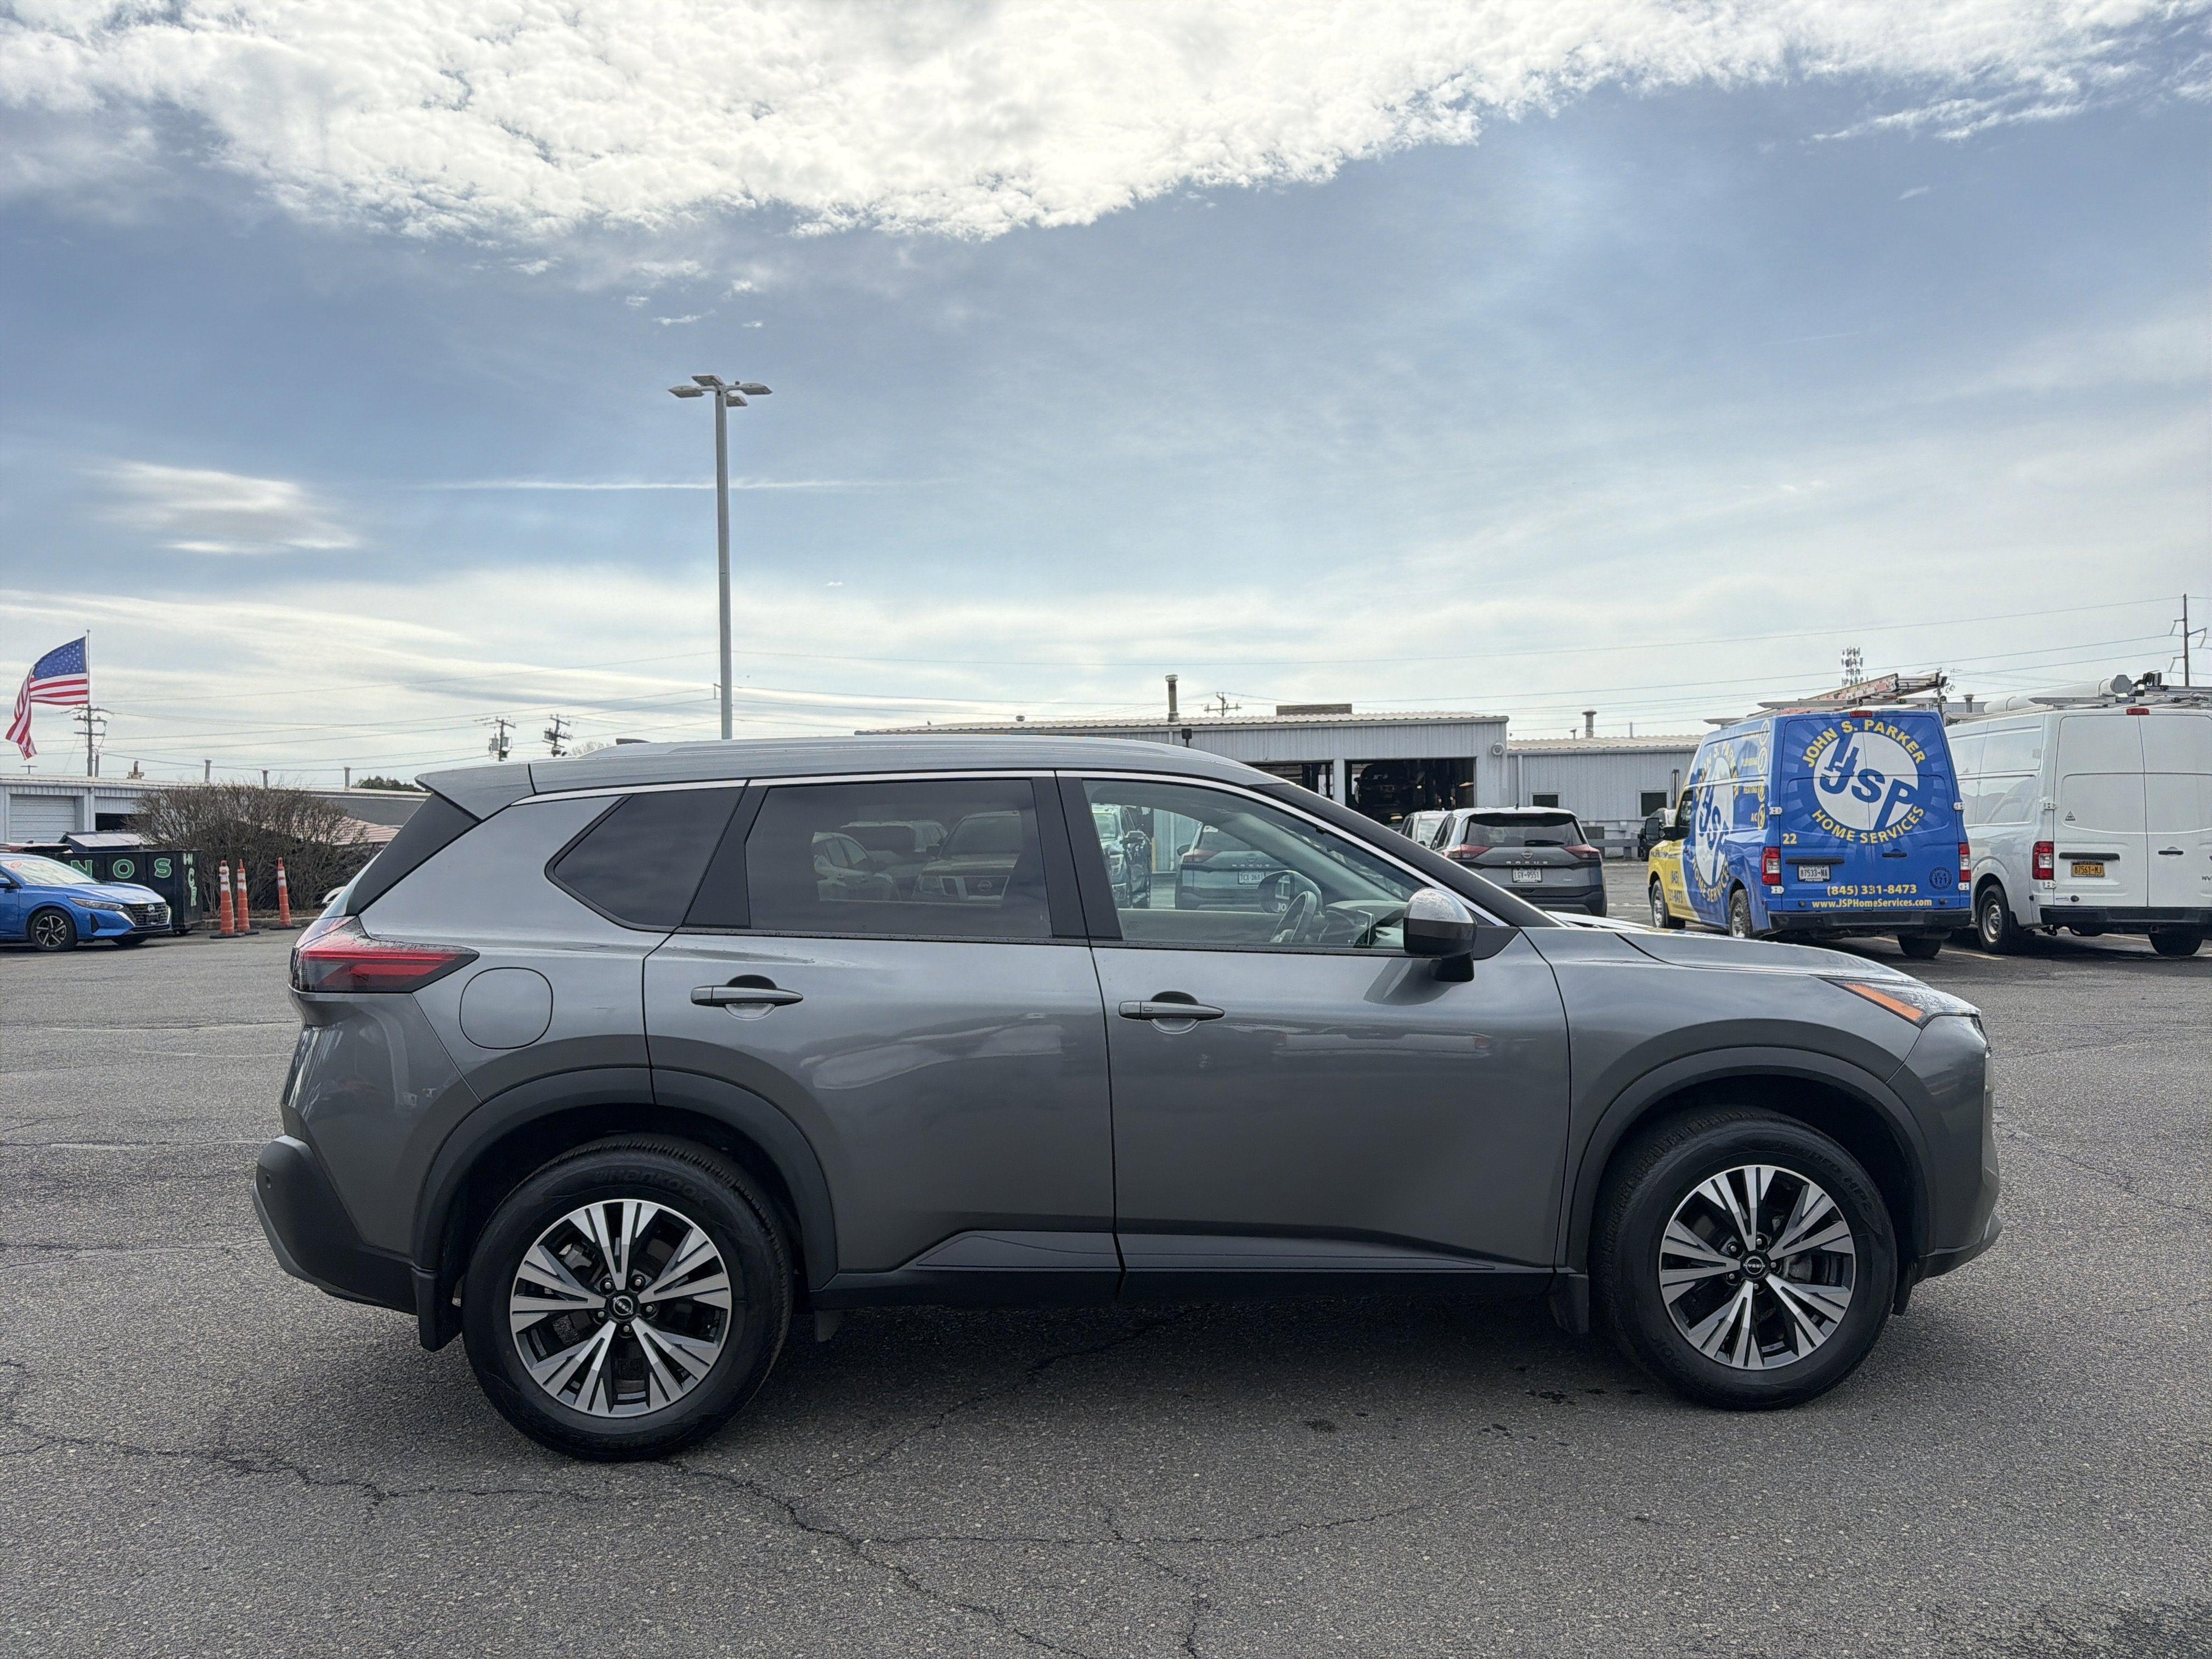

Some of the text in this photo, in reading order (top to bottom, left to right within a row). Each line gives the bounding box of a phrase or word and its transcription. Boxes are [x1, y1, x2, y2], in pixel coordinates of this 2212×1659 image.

[1803, 719, 1926, 768] JOHN S. PARKER
[1812, 806, 1925, 844] HOME SERVICES
[1782, 833, 1797, 845] 22
[1800, 869, 1828, 877] 87533-NA
[1827, 884, 1917, 896] (845) 331-8473
[1812, 898, 1933, 908] www.JSPHomeServices.com
